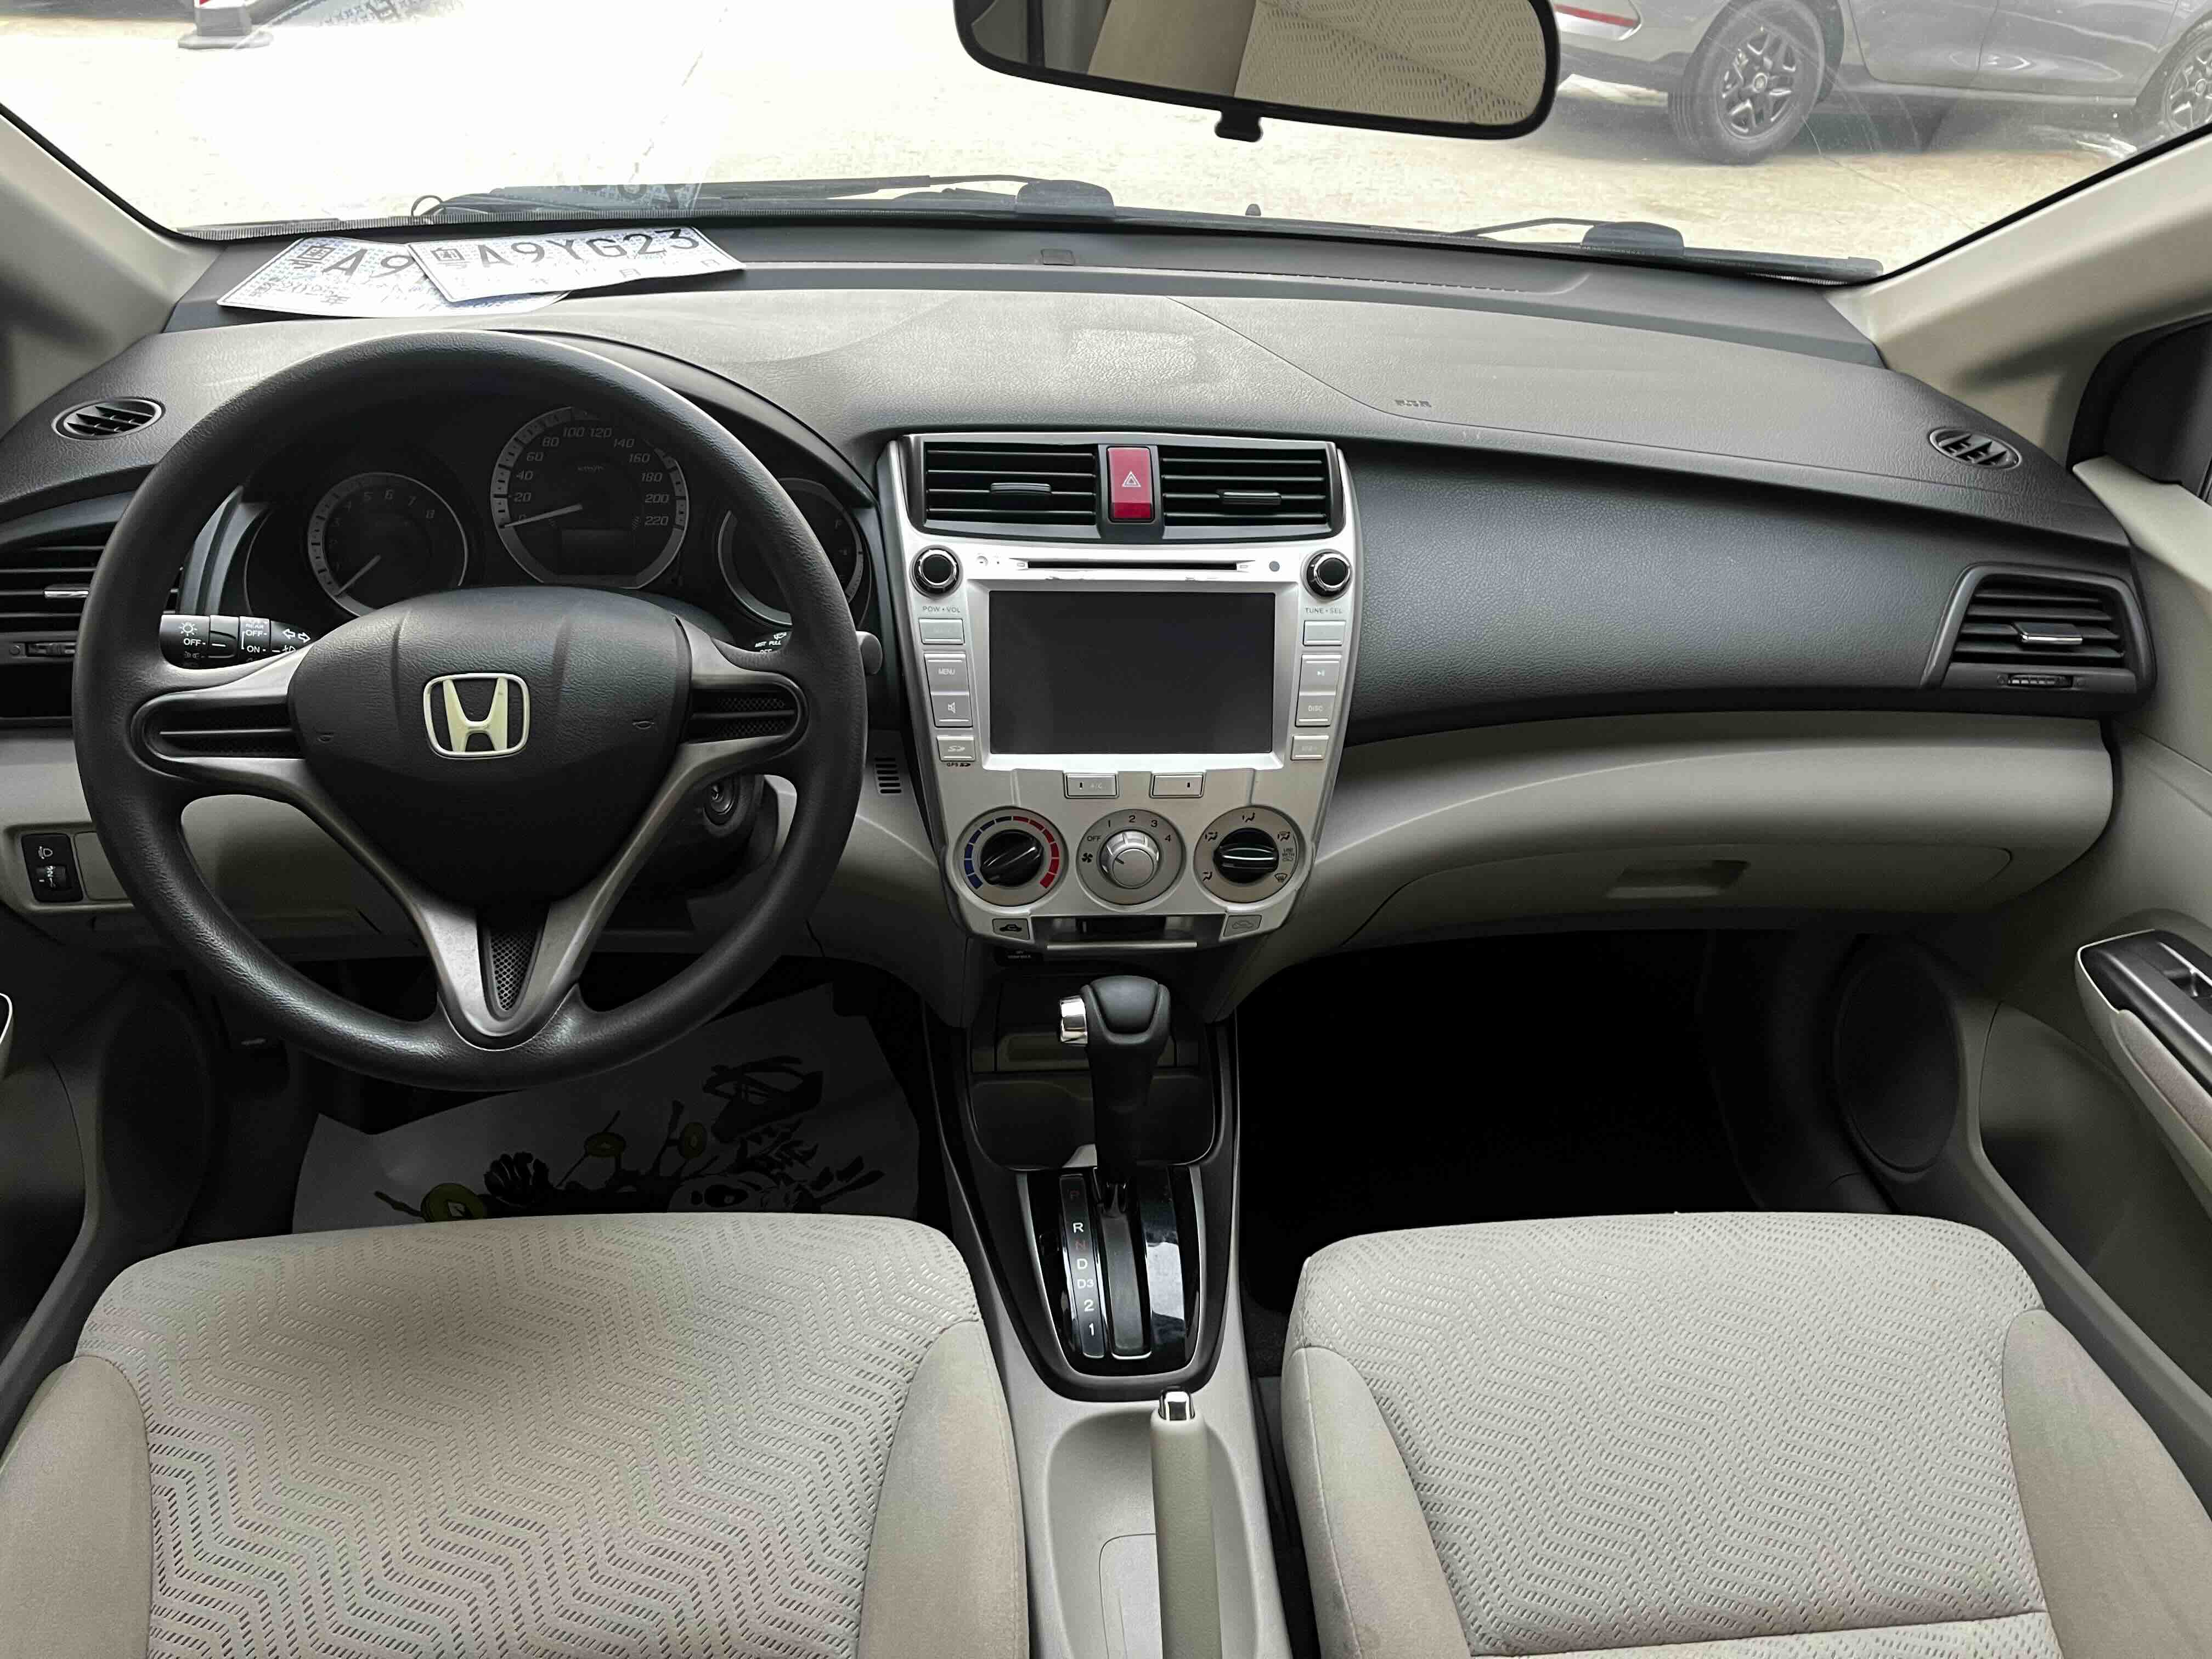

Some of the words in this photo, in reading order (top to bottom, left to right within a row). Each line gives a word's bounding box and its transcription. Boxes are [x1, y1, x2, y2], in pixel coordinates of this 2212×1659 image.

[563, 427, 585, 438] 100
[590, 427, 612, 438] 120
[542, 437, 560, 447] 80
[614, 438, 635, 448] 140
[526, 452, 544, 462] 60
[628, 453, 650, 463] 160
[516, 470, 534, 481] 40
[641, 472, 663, 483] 180
[514, 492, 532, 503] 20
[645, 494, 670, 504] 200
[645, 516, 669, 526] 220
[183, 637, 202, 646] OFF
[247, 645, 261, 653] ON
[1108, 820, 1111, 828] 1
[1128, 815, 1136, 823] 2
[1151, 820, 1158, 828] 3
[1164, 834, 1171, 842] 4
[1073, 1222, 1084, 1233] R
[1076, 1240, 1088, 1251] N
[1077, 1258, 1088, 1271] D
[1077, 1278, 1095, 1290] D3
[1084, 1299, 1095, 1312] 2
[1088, 1322, 1095, 1337] 1
